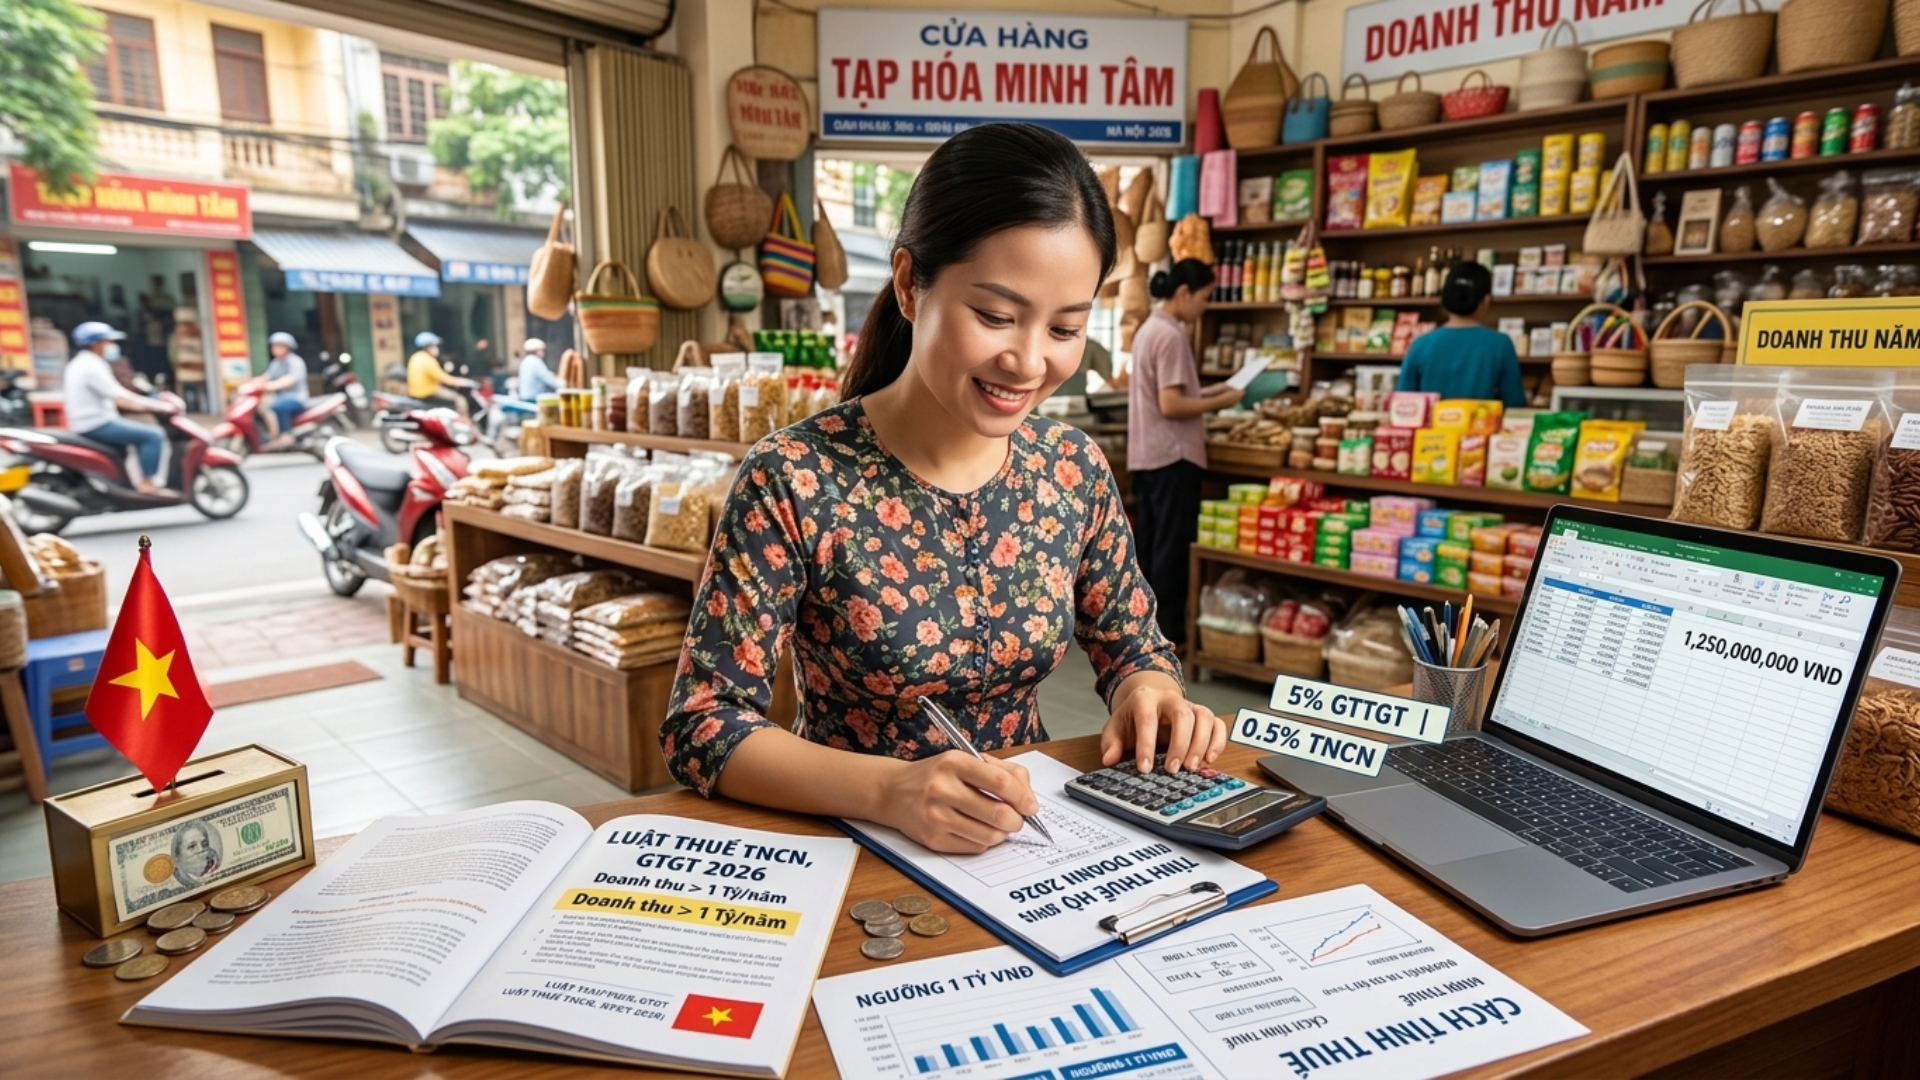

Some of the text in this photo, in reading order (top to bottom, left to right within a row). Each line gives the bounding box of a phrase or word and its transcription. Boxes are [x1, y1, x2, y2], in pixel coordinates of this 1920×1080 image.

[920, 18, 1089, 49] CỬA HÀNG
[1365, 4, 1480, 62] DOANH
[1492, 0, 1560, 37] THU
[831, 58, 899, 108] TẠP
[912, 51, 982, 102] HÓA
[995, 63, 1088, 105] MINH
[1100, 56, 1174, 107] TÂM
[1757, 324, 1920, 349] DOANH THU NĂM
[1684, 630, 1842, 686] 1,250,000,000 VND
[1287, 685, 1324, 711] 5%
[1330, 694, 1409, 727] GTTGT
[1242, 717, 1376, 768] 0.5% TNCN
[607, 829, 814, 868] LUẬT THUẾ TNCN,
[594, 872, 650, 887] Doanh
[654, 878, 685, 892] thu
[708, 885, 716, 895] 1
[636, 853, 767, 881] GTGT 2026
[572, 892, 635, 911] Doanh
[640, 899, 674, 915] thu
[699, 907, 709, 919] 1
[948, 978, 960, 991] 1
[990, 965, 1034, 983] VNĐ
